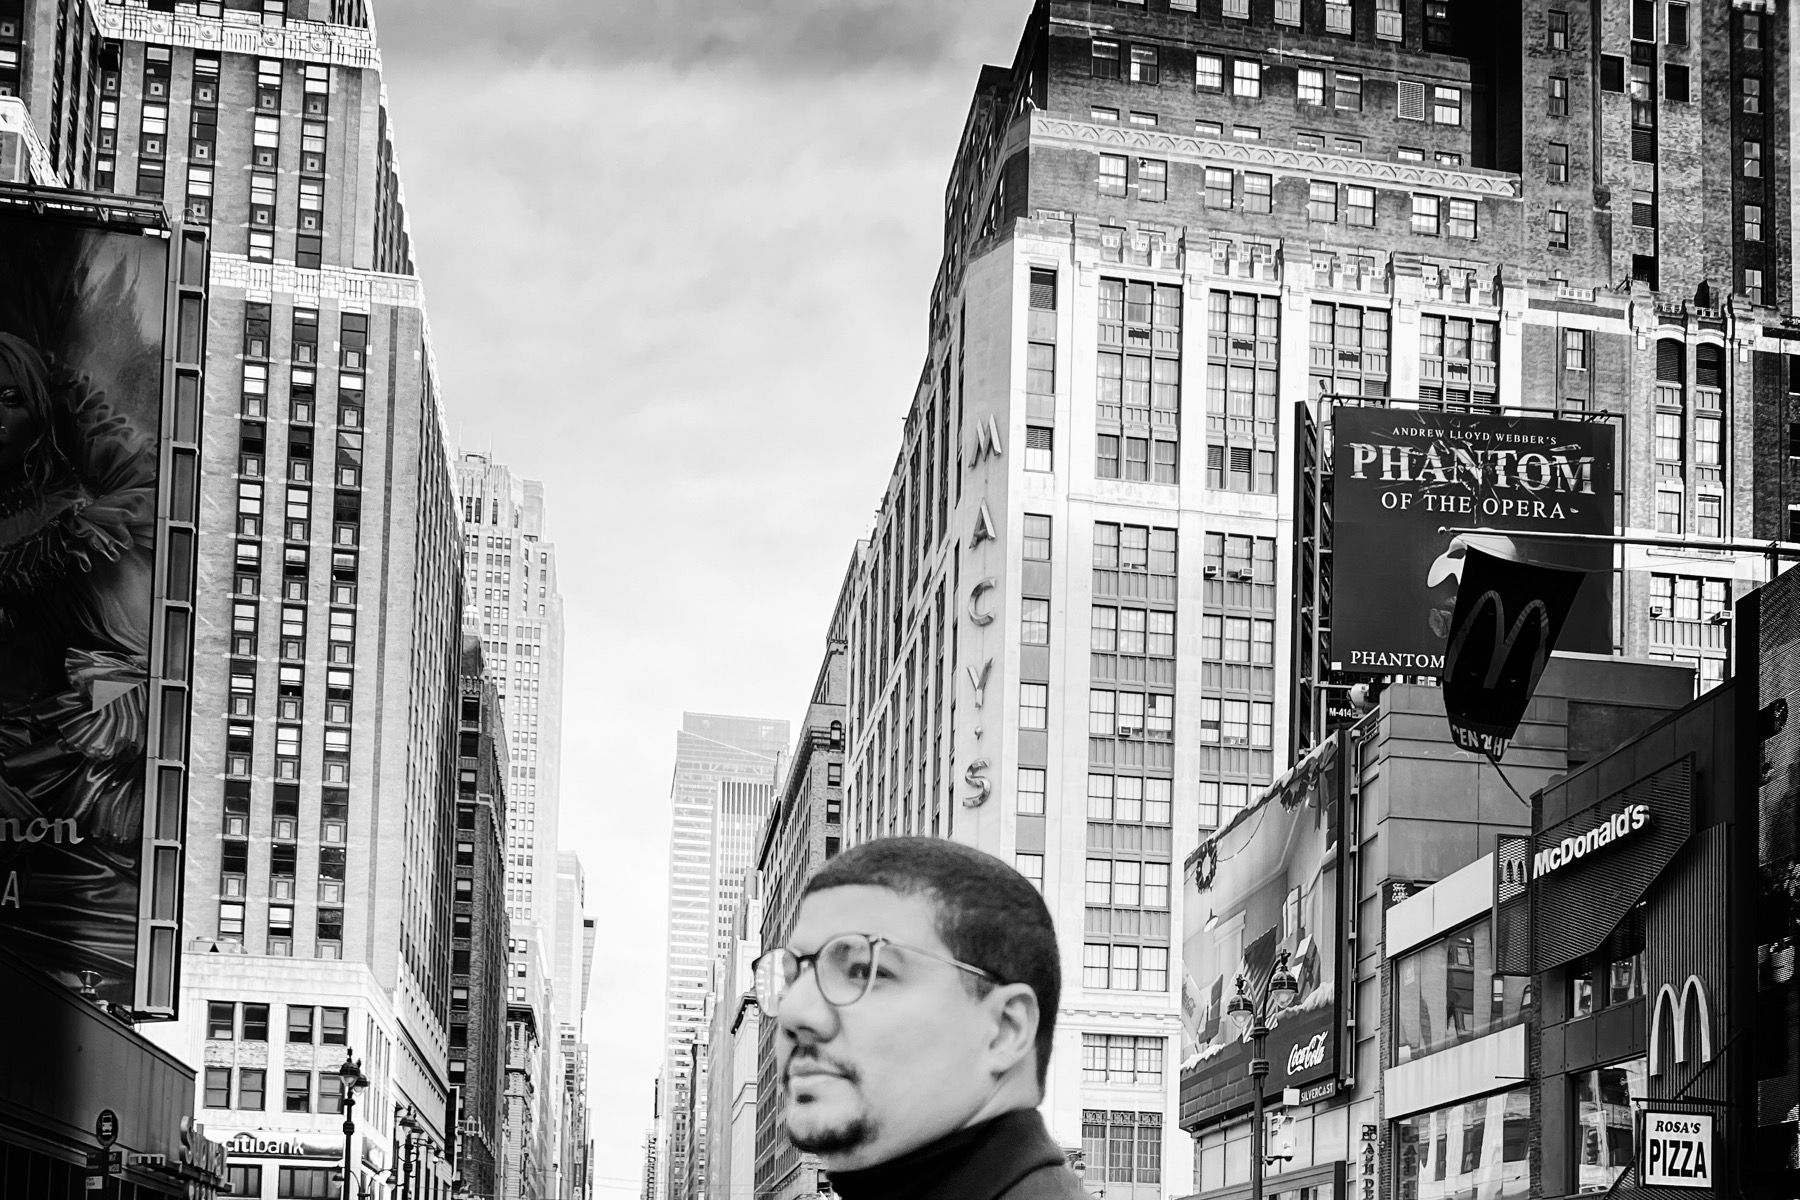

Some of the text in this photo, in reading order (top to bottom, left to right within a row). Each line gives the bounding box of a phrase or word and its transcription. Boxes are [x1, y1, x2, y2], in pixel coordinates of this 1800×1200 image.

[1392, 426, 1558, 446] ANDREW LLOYD WEBBER'S
[1348, 441, 1597, 496] PHANTOM
[1381, 491, 1566, 520] OF THE OPERA
[1328, 706, 1352, 719] M-414
[1533, 804, 1649, 880] McDonald's
[1300, 1082, 1334, 1102] SILVERCAST
[1655, 1120, 1701, 1134] ROSA'S
[222, 1132, 304, 1155] citibank
[1649, 1138, 1707, 1179] PIZZA
